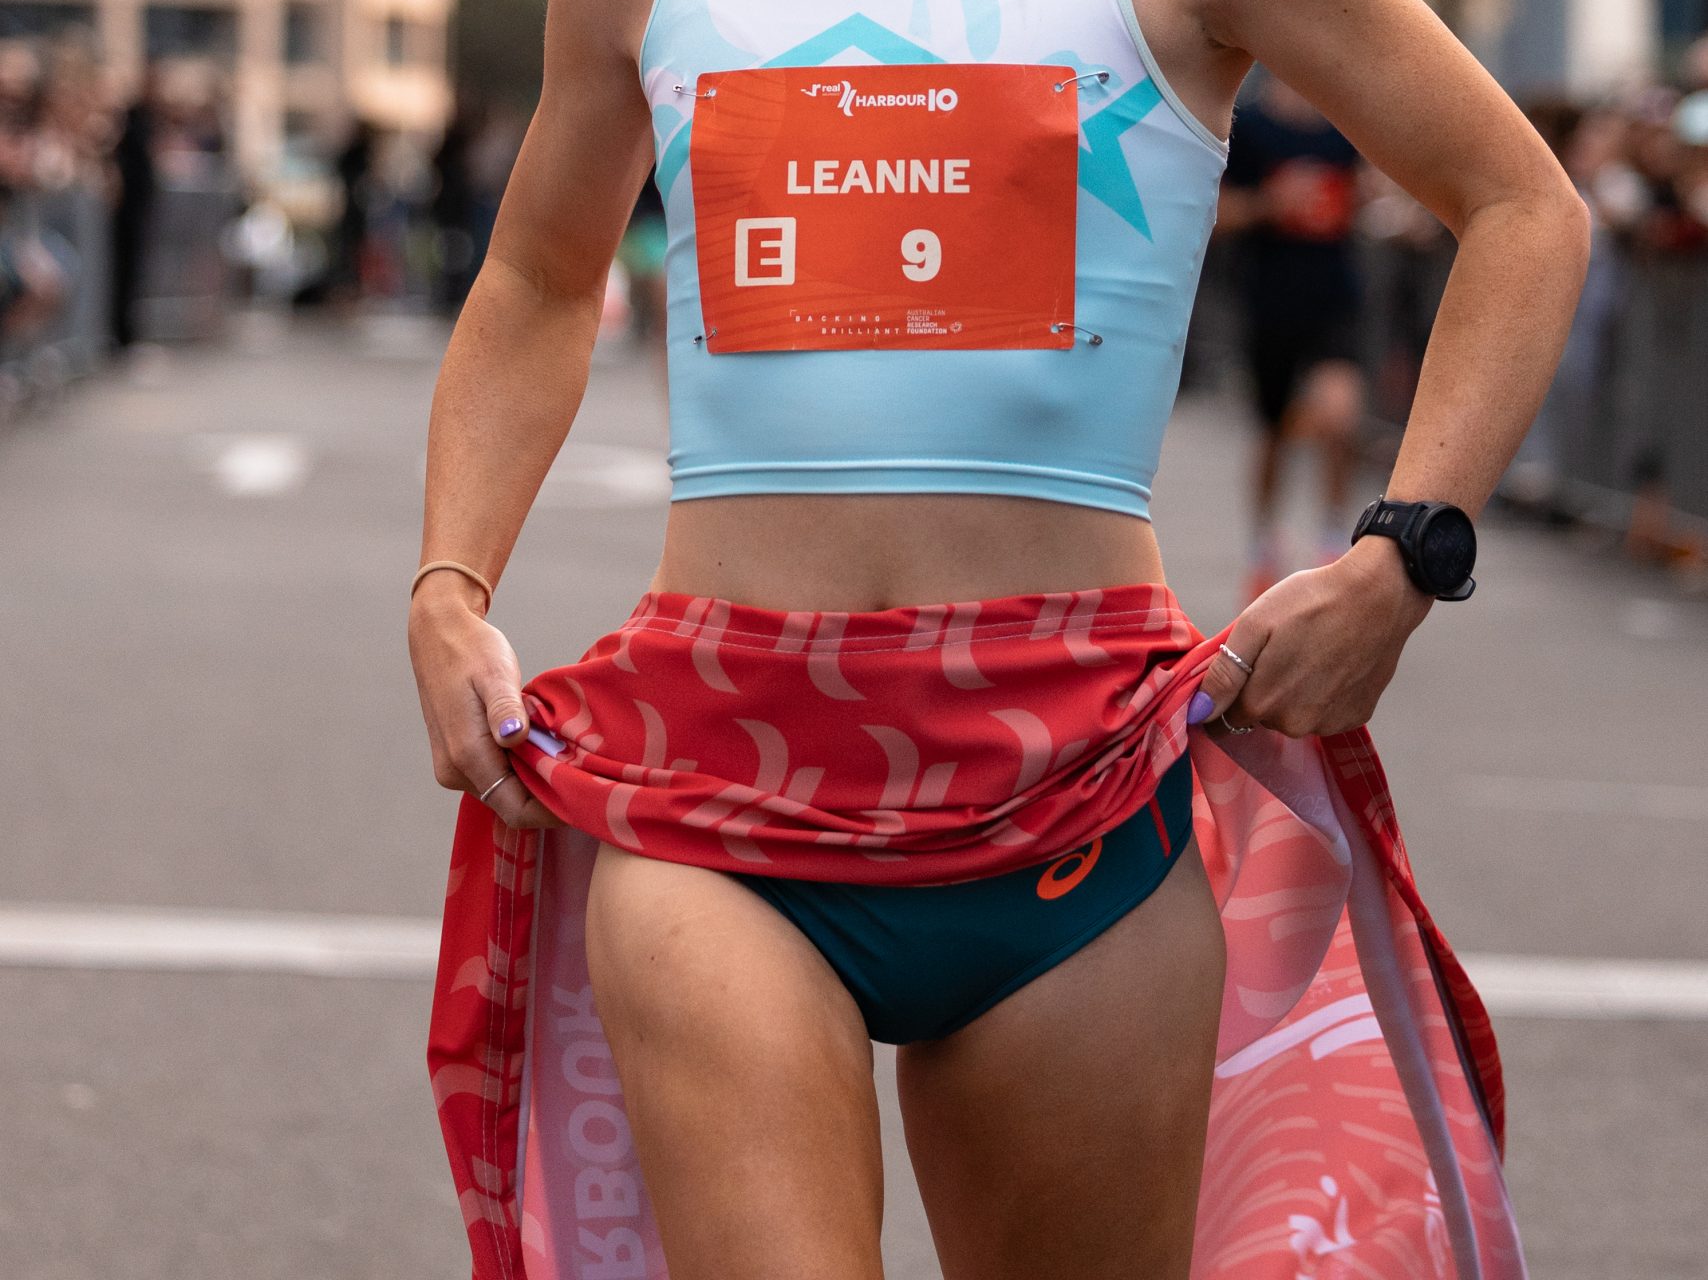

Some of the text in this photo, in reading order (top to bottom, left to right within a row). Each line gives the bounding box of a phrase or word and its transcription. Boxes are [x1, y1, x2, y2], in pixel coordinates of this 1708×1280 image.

[822, 83, 841, 92] real
[787, 159, 970, 195] LEANNE
[747, 227, 783, 278] E
[901, 228, 942, 282] 9
[795, 315, 880, 323] BACKING
[821, 327, 900, 335] BRILLIANT
[906, 327, 948, 335] FOUNDATION
